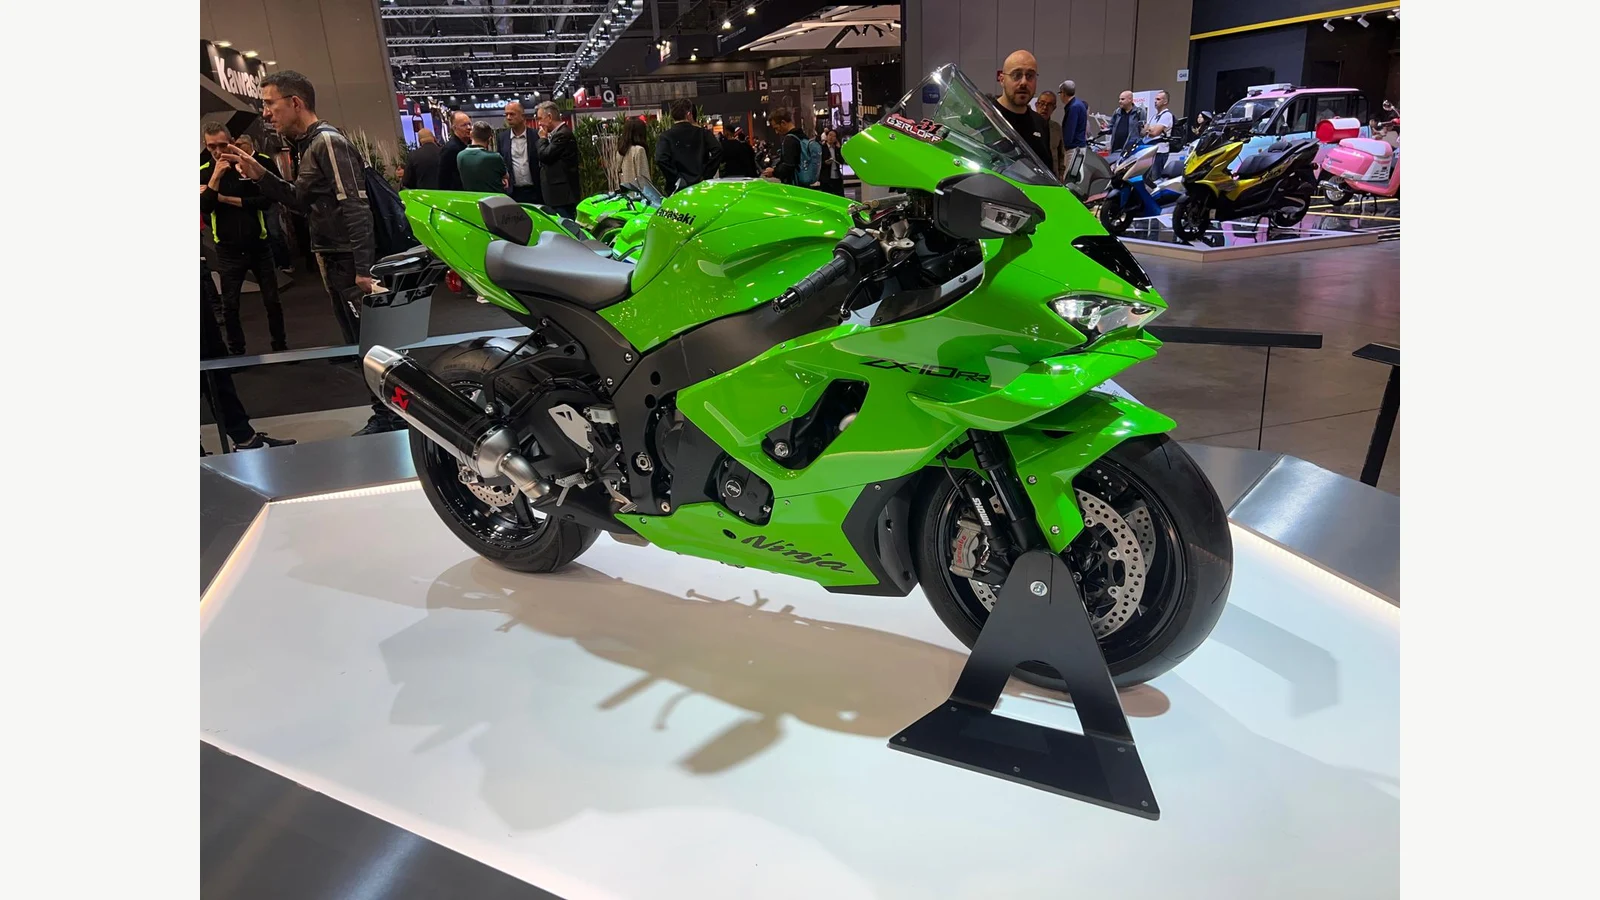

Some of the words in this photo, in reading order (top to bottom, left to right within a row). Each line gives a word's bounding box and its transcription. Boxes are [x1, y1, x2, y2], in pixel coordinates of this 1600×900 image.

[214, 56, 265, 99] Kawasa
[602, 89, 615, 103] Q
[886, 117, 941, 142] GERLOFF
[859, 356, 991, 383] ZX-10RR
[972, 497, 992, 527] SHOWA
[741, 535, 854, 573] Ninja
